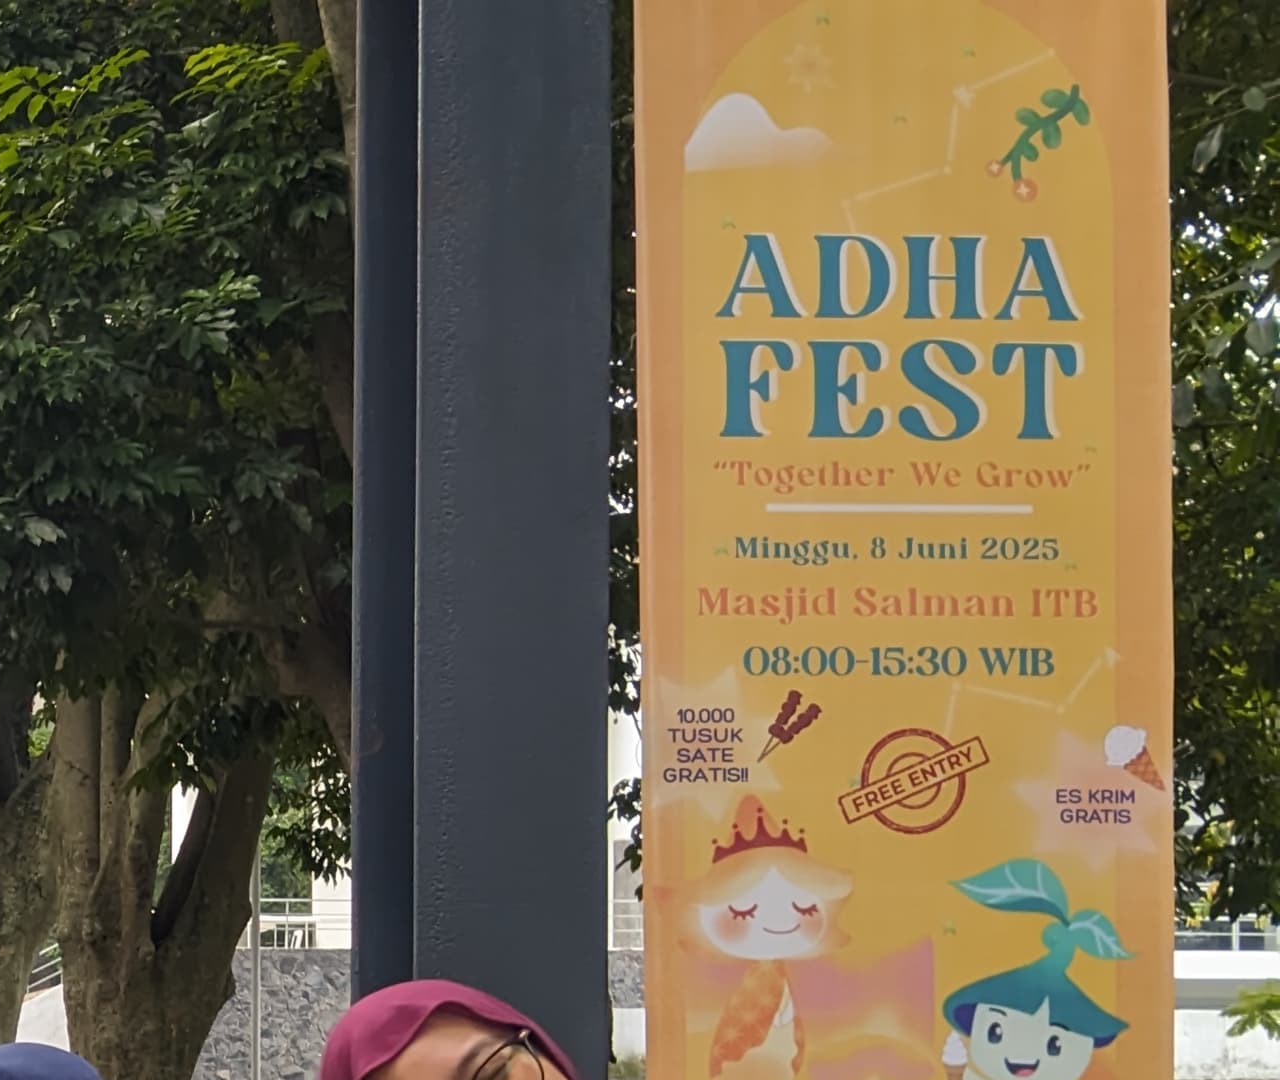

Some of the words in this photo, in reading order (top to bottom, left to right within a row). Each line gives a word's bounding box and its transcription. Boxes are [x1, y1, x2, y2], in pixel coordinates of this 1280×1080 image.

[715, 232, 1083, 321] ADHA
[718, 338, 1083, 442] FEST
[909, 462, 961, 487] We
[869, 537, 887, 560] 8
[898, 537, 969, 560] Juni
[980, 537, 1060, 560] 2025
[697, 586, 837, 625] Masjid
[853, 586, 1015, 618] Salman
[1031, 587, 1099, 618] ITB
[742, 646, 968, 677] 08:00-15:30
[979, 646, 1056, 677] WIB
[677, 707, 735, 724] 10.000
[668, 728, 744, 743] TUSUK
[676, 748, 735, 763] SATE
[663, 767, 749, 783] GRATIS!!
[852, 778, 906, 813] FREE
[908, 746, 973, 788] ENTRY
[1056, 789, 1082, 804] ES
[1088, 789, 1136, 804] KRIM
[1060, 808, 1132, 824] GRATIS
